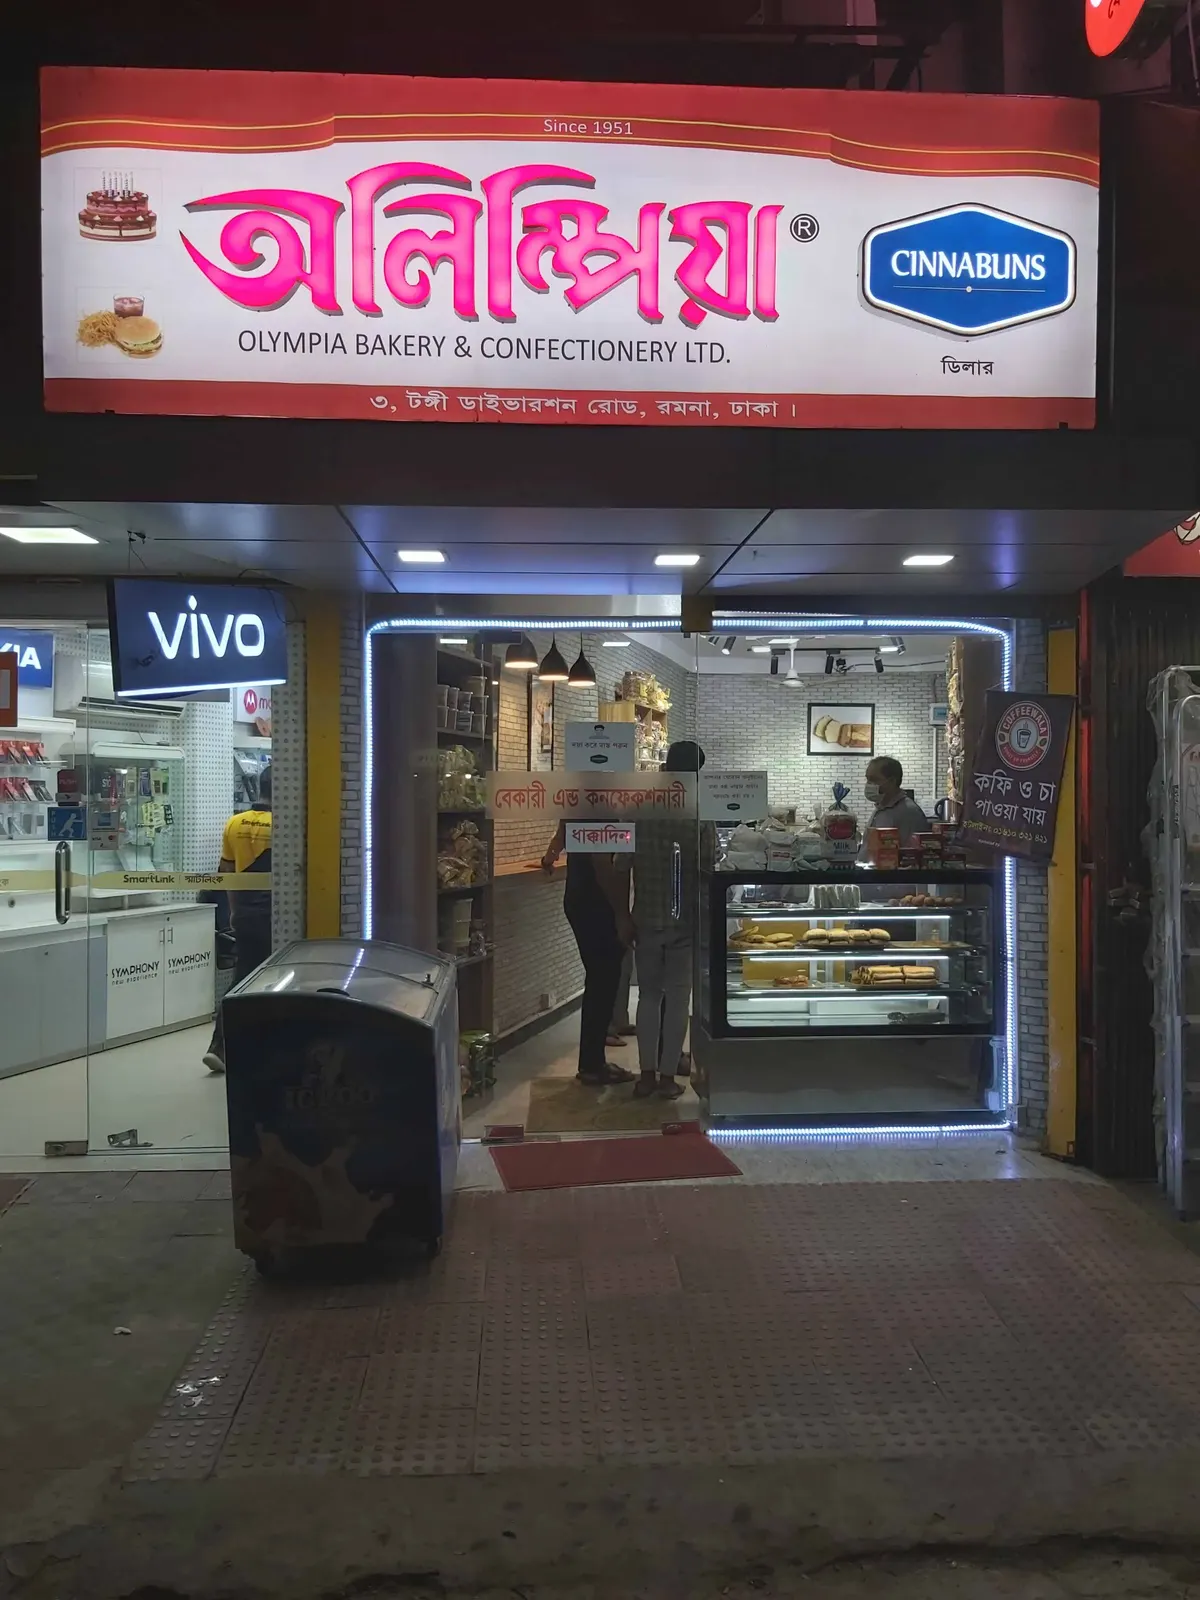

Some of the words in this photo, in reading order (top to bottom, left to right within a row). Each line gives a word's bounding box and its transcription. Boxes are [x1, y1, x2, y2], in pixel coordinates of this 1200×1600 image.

[544, 119, 587, 133] Since
[593, 121, 633, 135] 1951
[179, 161, 784, 329] অলিম্পিয়া
[890, 250, 1046, 281] CINNABUNS
[238, 330, 347, 355] OLYMPIA
[355, 333, 446, 358] BAKERY
[454, 335, 473, 358] &
[480, 337, 677, 363] CONFECTIONERY
[686, 342, 731, 364] LTD.
[940, 355, 994, 376] ডিলার
[406, 390, 449, 411] টঙ্গী
[457, 392, 577, 414] ডাইভারশন
[588, 398, 646, 418] রোড,
[655, 399, 719, 420] রমনা,
[1002, 706, 1047, 734] COFFEEWALA
[495, 780, 546, 809] বেকারী
[584, 780, 687, 810] কনফেকশনারী
[974, 769, 1014, 796] কফি
[1019, 781, 1033, 798] ও
[1038, 781, 1056, 804] চা
[975, 798, 1019, 821] পাওয়া
[1021, 806, 1047, 826] যায়
[111, 961, 160, 978] SYMPHONY
[168, 951, 211, 969] SYMPHONY
